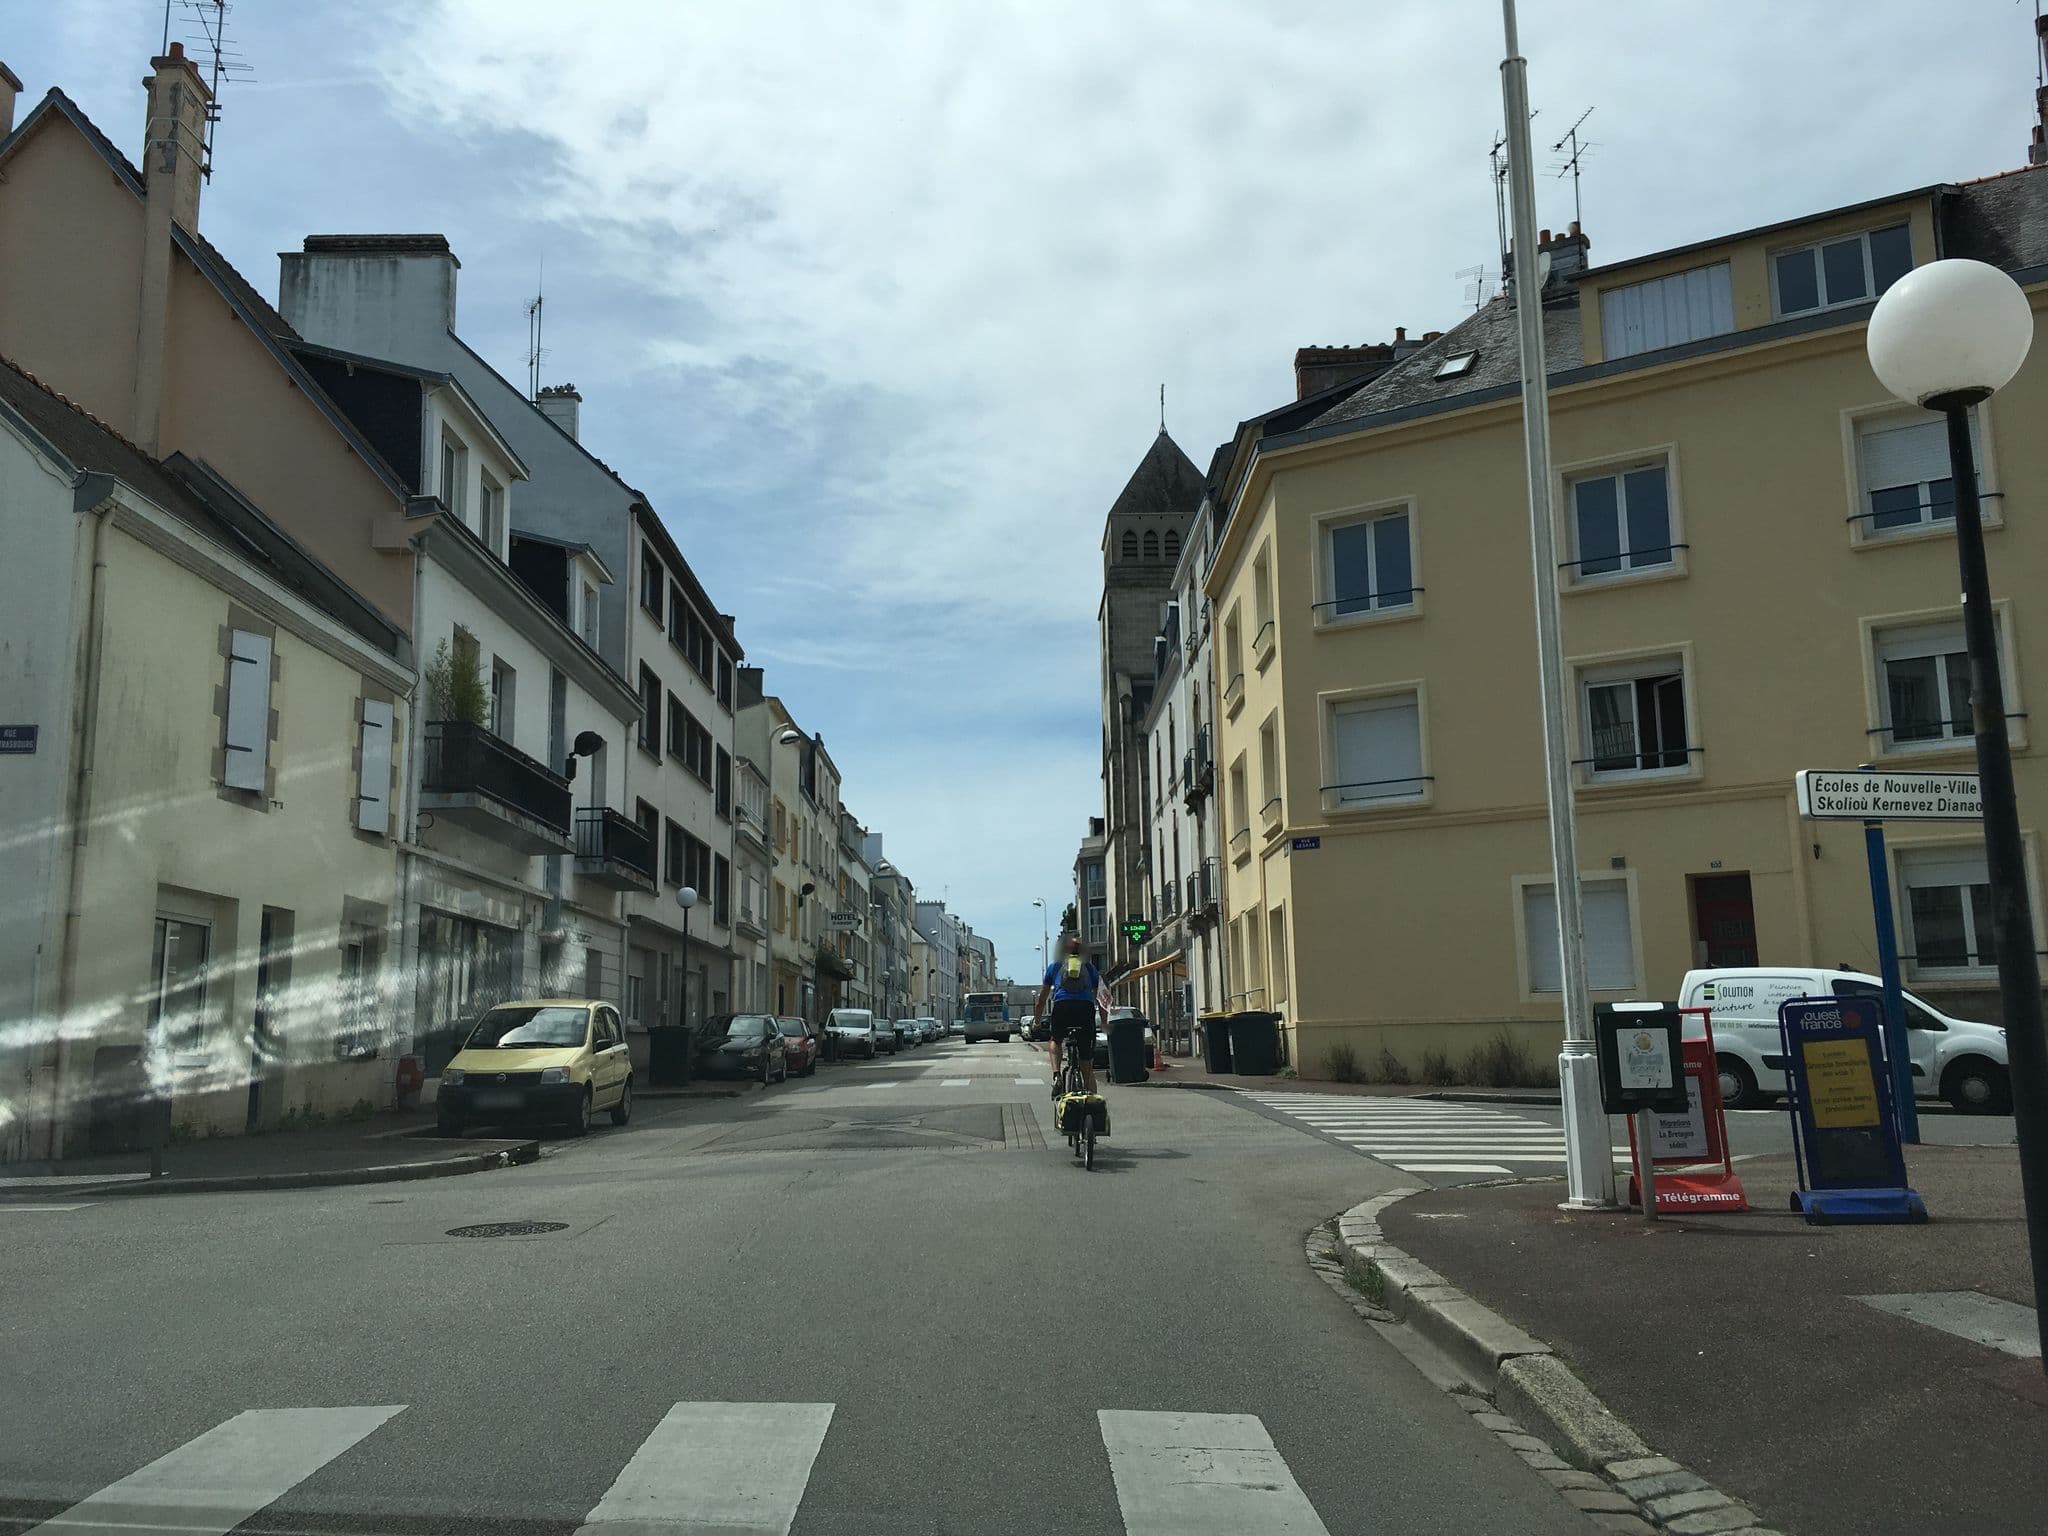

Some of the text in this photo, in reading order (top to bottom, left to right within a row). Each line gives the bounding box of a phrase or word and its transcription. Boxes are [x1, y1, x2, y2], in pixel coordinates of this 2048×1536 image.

[1816, 776, 1977, 795] Écoles de Nouvelle-Ville
[1817, 796, 1868, 811] Skolioù
[1872, 797, 1933, 812] Kernevez
[831, 913, 859, 921] HOTEL
[1711, 1002, 1755, 1013] einture
[1804, 1009, 1841, 1020] ouest
[1800, 1019, 1842, 1030] france
[1663, 1192, 1741, 1204] Télégramme
